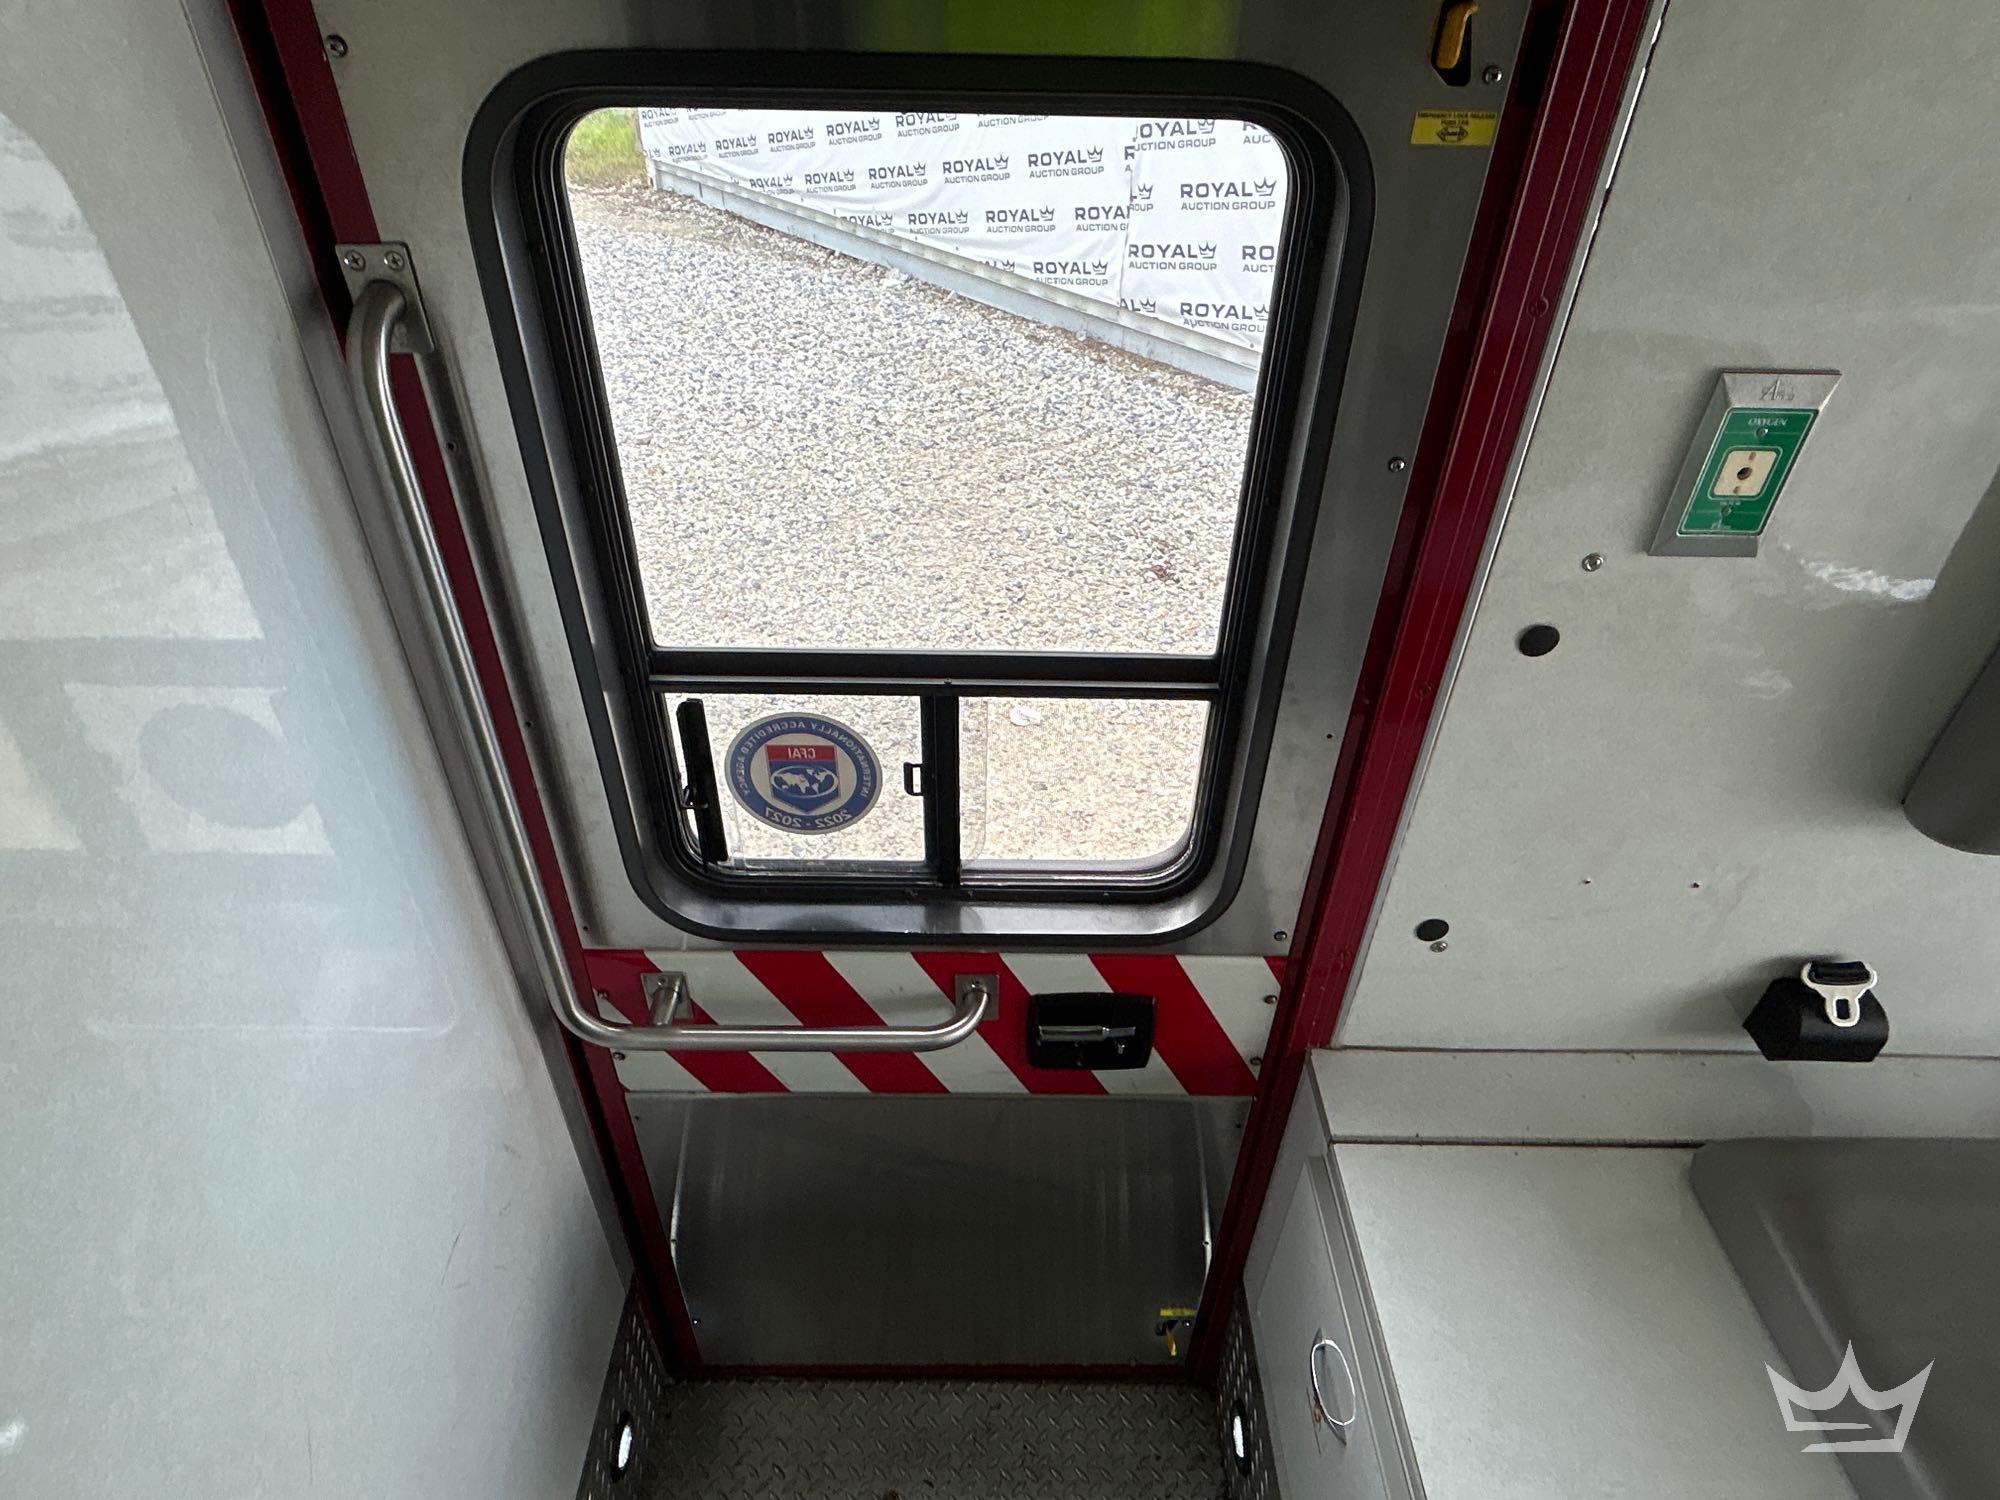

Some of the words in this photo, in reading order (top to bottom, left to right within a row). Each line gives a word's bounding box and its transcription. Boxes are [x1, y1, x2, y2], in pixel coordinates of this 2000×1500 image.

[642, 109, 670, 120] ROYAL
[895, 113, 944, 127] ROYAL
[826, 120, 869, 136] ROYAL
[978, 117, 1017, 128] AUCTION
[897, 128, 931, 137] AUCTION
[932, 123, 959, 133] GROUP
[1136, 120, 1197, 139] OYAL
[768, 129, 804, 144] ROYAL
[828, 137, 858, 146] AUCTION
[858, 133, 882, 142] GROUP
[668, 143, 699, 156] ROYAL
[715, 137, 748, 151] ROYAL
[795, 141, 816, 150] GROUP
[1135, 141, 1176, 151] UCTION
[1178, 138, 1216, 149] GROUP
[1028, 149, 1087, 167] ROYAL
[942, 157, 995, 174] ROYAL
[1029, 168, 1070, 179] AUCTION
[1071, 165, 1104, 176] GROUP
[804, 171, 844, 184] ROYAL
[868, 165, 914, 180] ROYAL
[944, 175, 980, 184] AUCTION
[981, 172, 1010, 182] GROUP
[871, 181, 902, 190] AUCTION
[902, 179, 928, 188] GROUP
[1180, 181, 1253, 198] ROYAL
[1130, 203, 1154, 211] ROUP
[1181, 202, 1230, 211] AUCTION
[1232, 201, 1275, 210] GROUP
[908, 211, 956, 225] ROYAL
[986, 209, 1040, 223] ROYAL
[942, 226, 969, 234] GROUP
[986, 225, 1024, 233] AUCTION
[1025, 224, 1056, 232] GROUP
[1128, 244, 1198, 259] ROYAL
[1034, 261, 1093, 275] ROYAL
[1129, 262, 1177, 270] AUCTION
[1178, 262, 1217, 271] GROUP
[1242, 264, 1275, 273] AUCT
[1076, 278, 1109, 287] GROUP
[1180, 302, 1253, 320] ROYAL
[1231, 323, 1266, 333] GROU
